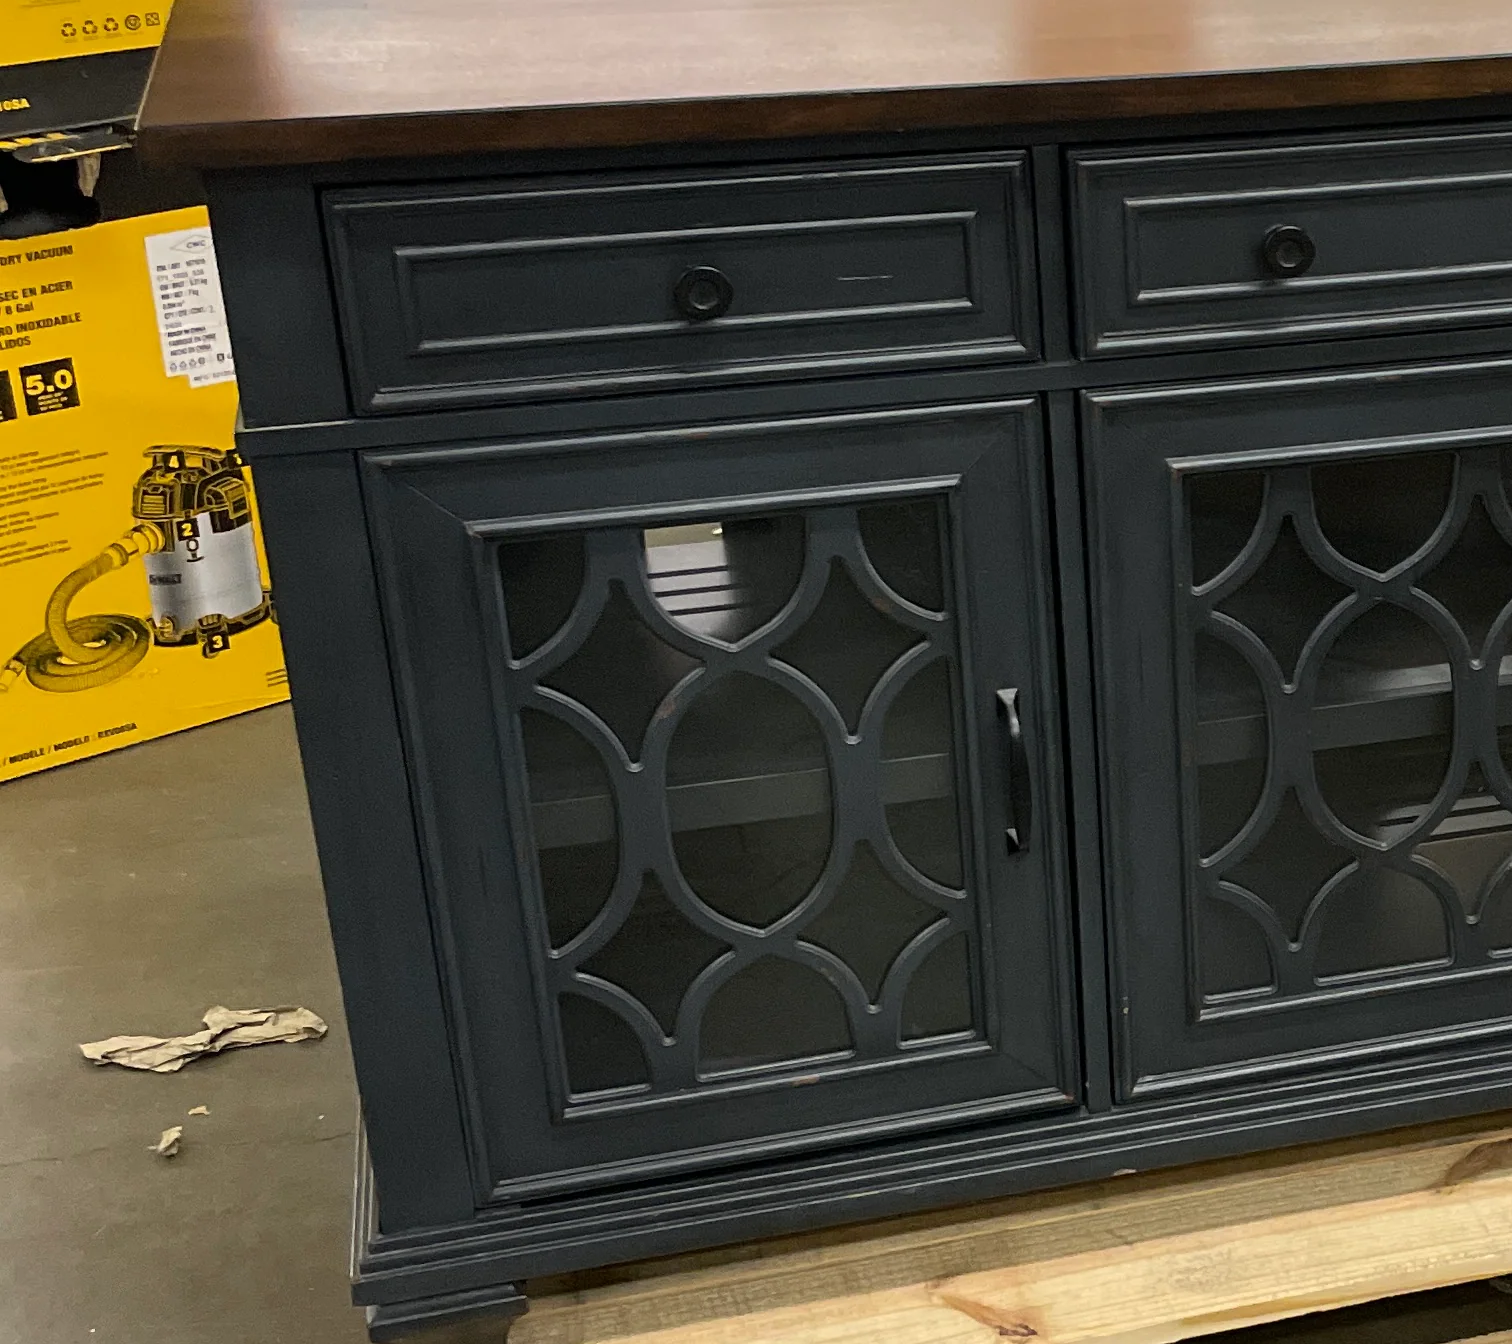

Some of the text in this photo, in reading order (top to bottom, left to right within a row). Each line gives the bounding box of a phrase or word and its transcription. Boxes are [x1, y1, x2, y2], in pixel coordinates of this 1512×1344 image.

[25, 244, 74, 262] VACUUM
[22, 287, 37, 299] EN
[40, 280, 74, 295] ACIER
[16, 301, 35, 314] Gal
[16, 312, 82, 334] INOXIDABLE
[25, 368, 74, 396] 5.0
[181, 523, 194, 537] 2
